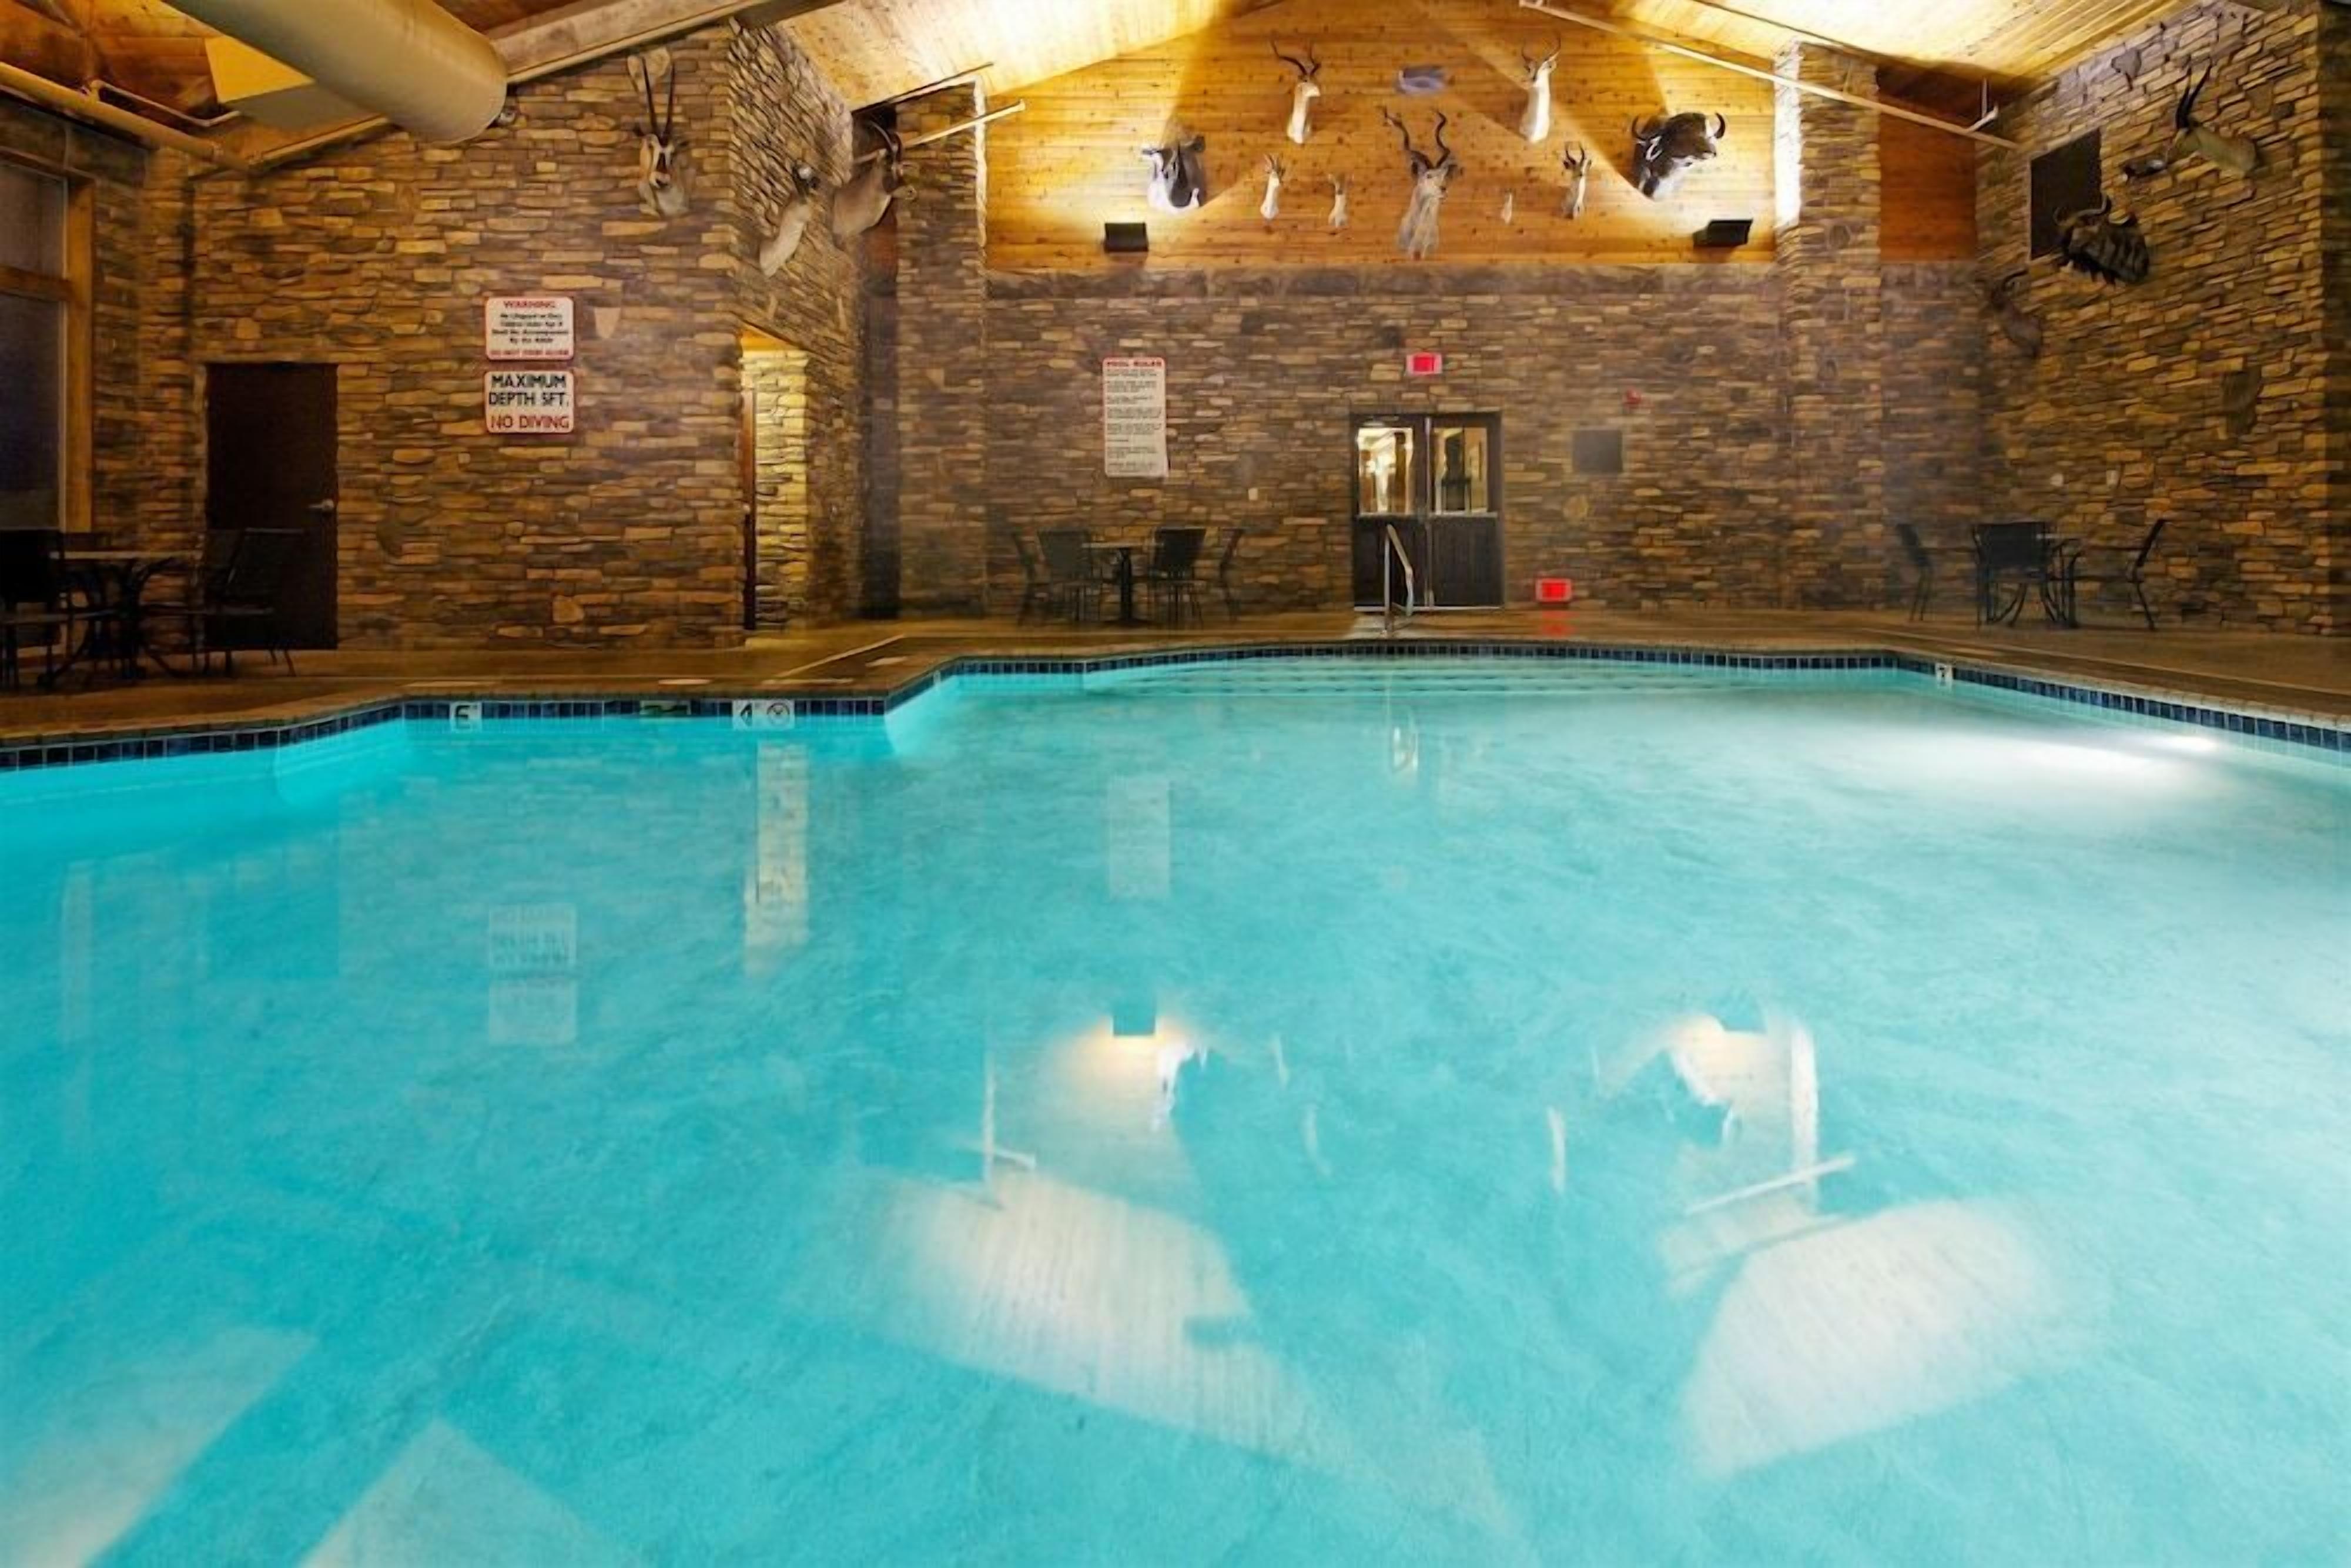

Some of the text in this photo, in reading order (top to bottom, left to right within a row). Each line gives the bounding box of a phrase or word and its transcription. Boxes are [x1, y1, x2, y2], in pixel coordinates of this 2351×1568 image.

[492, 374, 565, 387] MAXIMUM
[489, 392, 535, 405] DEPTH
[491, 415, 570, 428] NO DIVING
